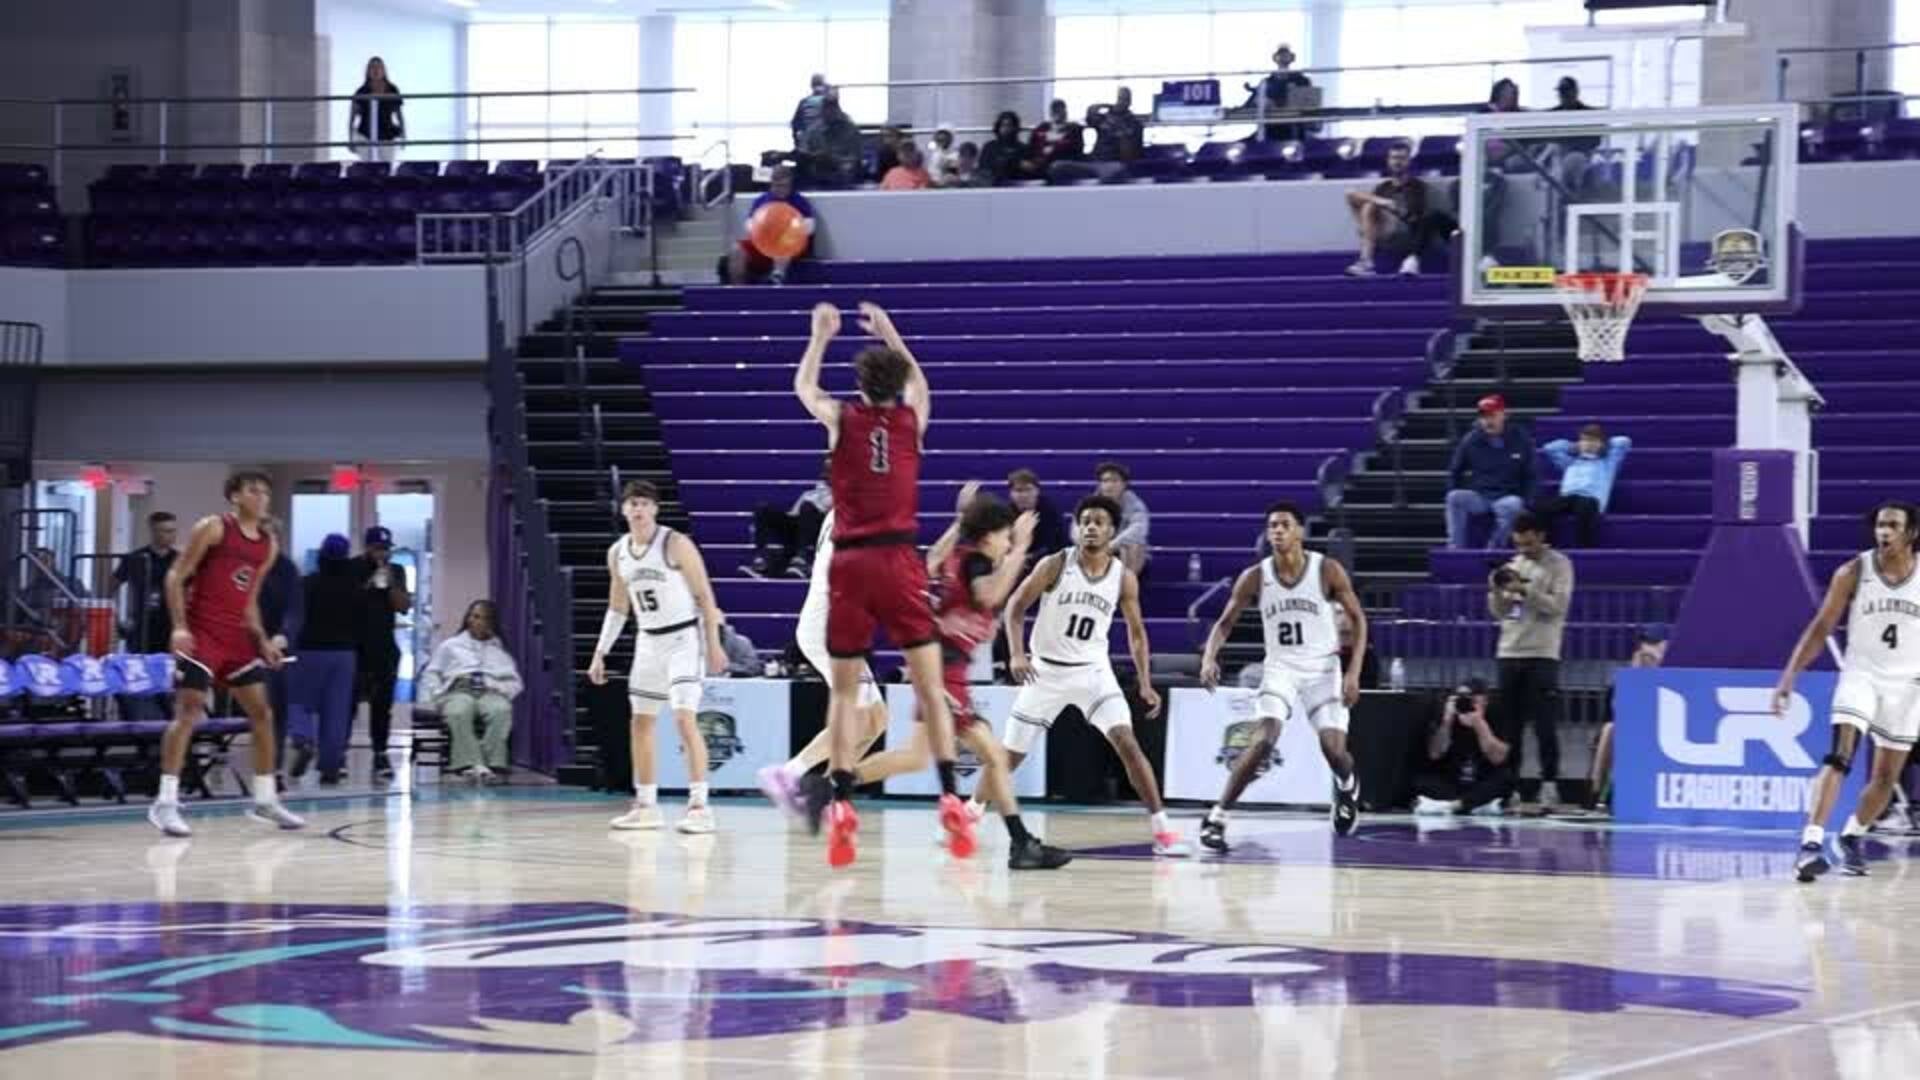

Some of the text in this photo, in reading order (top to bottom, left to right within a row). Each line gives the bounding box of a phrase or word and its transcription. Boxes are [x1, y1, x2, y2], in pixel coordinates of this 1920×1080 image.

[1183, 83, 1211, 101] 101
[636, 589, 659, 613] 15
[1058, 591, 1073, 606] LA
[1264, 602, 1277, 620] LA
[1065, 613, 1095, 641] 10
[1278, 622, 1304, 647] 21
[1881, 623, 1898, 650] 4
